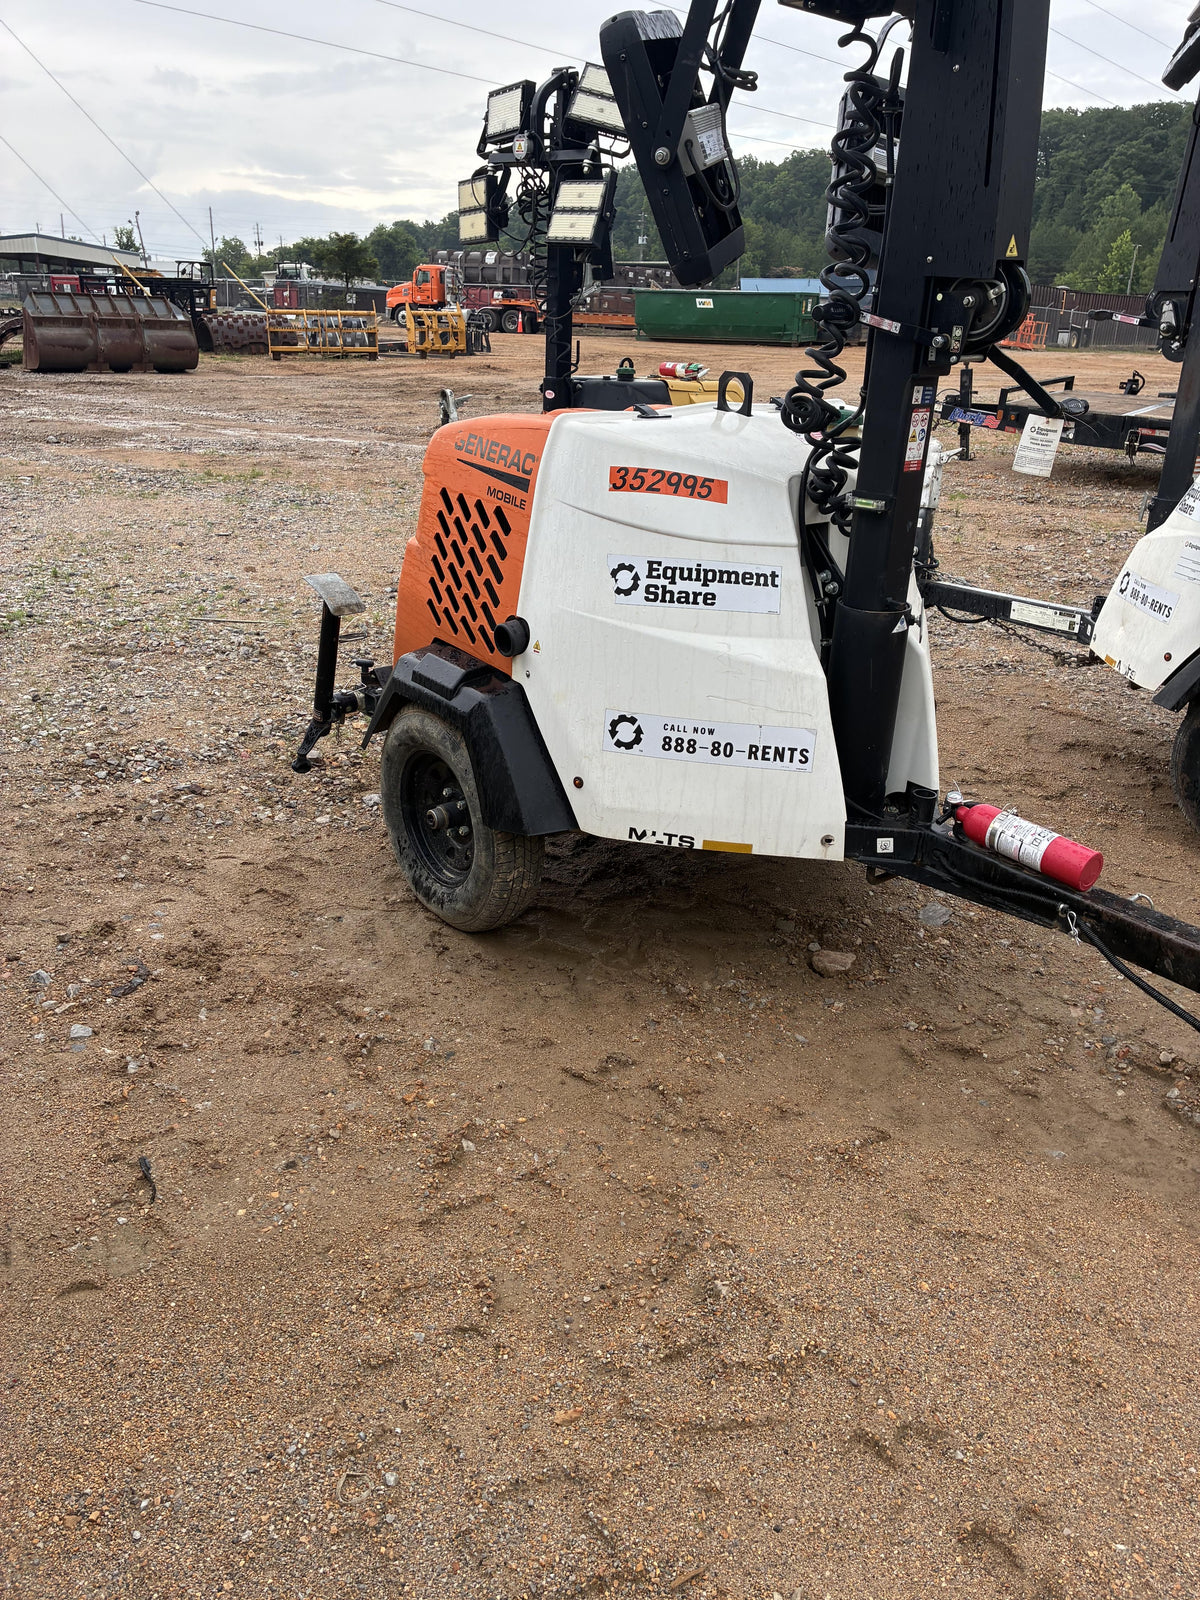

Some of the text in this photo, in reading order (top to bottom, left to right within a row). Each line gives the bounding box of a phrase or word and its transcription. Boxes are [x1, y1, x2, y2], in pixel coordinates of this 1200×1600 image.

[612, 466, 715, 499] 352995
[486, 486, 527, 510] MOBILE
[645, 559, 779, 588] Equipment
[643, 583, 717, 607] Share
[1129, 586, 1173, 619] 888-80-RENTS
[663, 723, 716, 736] CALL NOW
[661, 735, 810, 765] 888-80-RENTS
